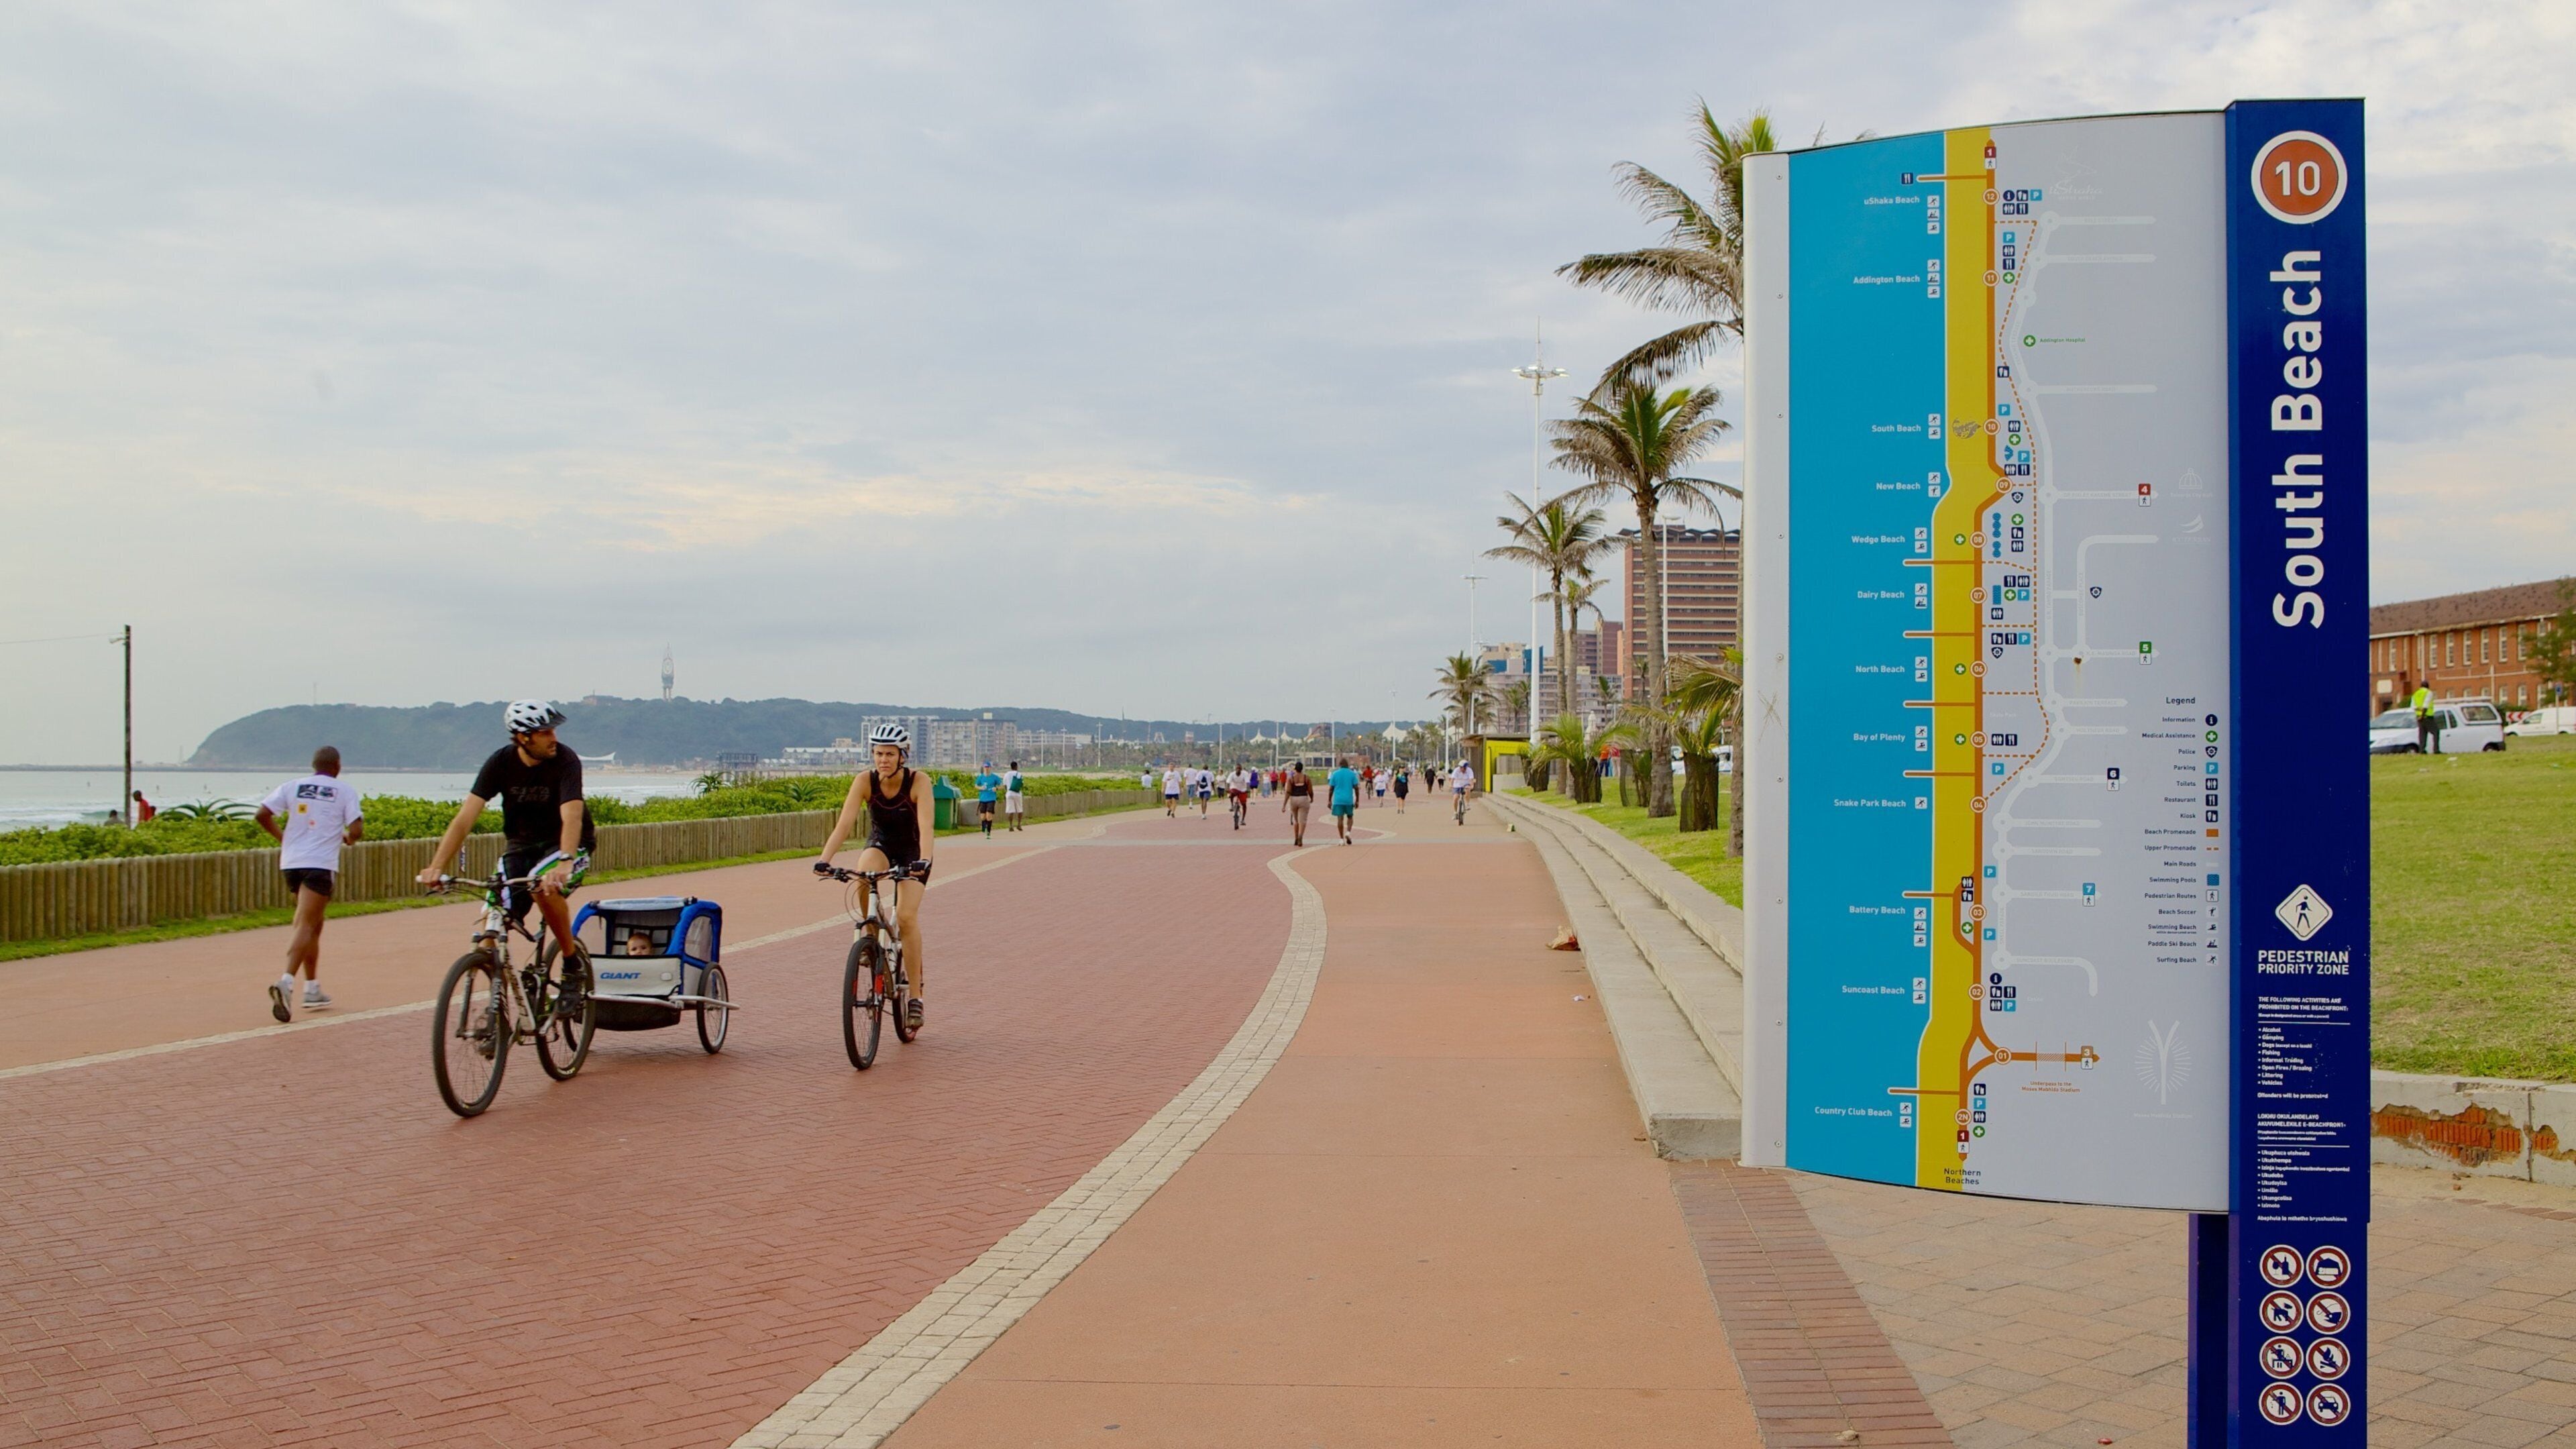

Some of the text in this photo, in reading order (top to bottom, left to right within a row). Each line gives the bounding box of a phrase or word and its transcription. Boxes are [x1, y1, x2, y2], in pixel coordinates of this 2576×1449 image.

[1986, 148, 1992, 156] 1
[2275, 160, 2321, 197] 10
[1864, 195, 1920, 205] uShaka Beach
[1853, 274, 1921, 285] Addington Beach
[1872, 424, 1921, 433] South Beach
[2269, 250, 2325, 629] South Beach
[1876, 482, 1921, 490] New Beach
[1851, 535, 1879, 545] Wedge
[1857, 590, 1905, 600] Dairy Beach
[1880, 665, 1905, 673] Beach
[2165, 696, 2196, 706] Legend
[1853, 733, 1869, 742] Bay
[1880, 733, 1906, 743] Plenty
[2109, 770, 2116, 778] 6
[1834, 799, 1907, 807] Snake Park Beach
[1849, 905, 1906, 915] Battery Beach
[2258, 950, 2349, 963] PEDESTRIAN
[2258, 964, 2349, 975] PRIORITY ZONE
[1841, 985, 1905, 994] Suncoast Beach
[1815, 1106, 1892, 1117] Country Club Beach
[1944, 1168, 1981, 1176] Northern
[1945, 1176, 1980, 1185] Beaches
